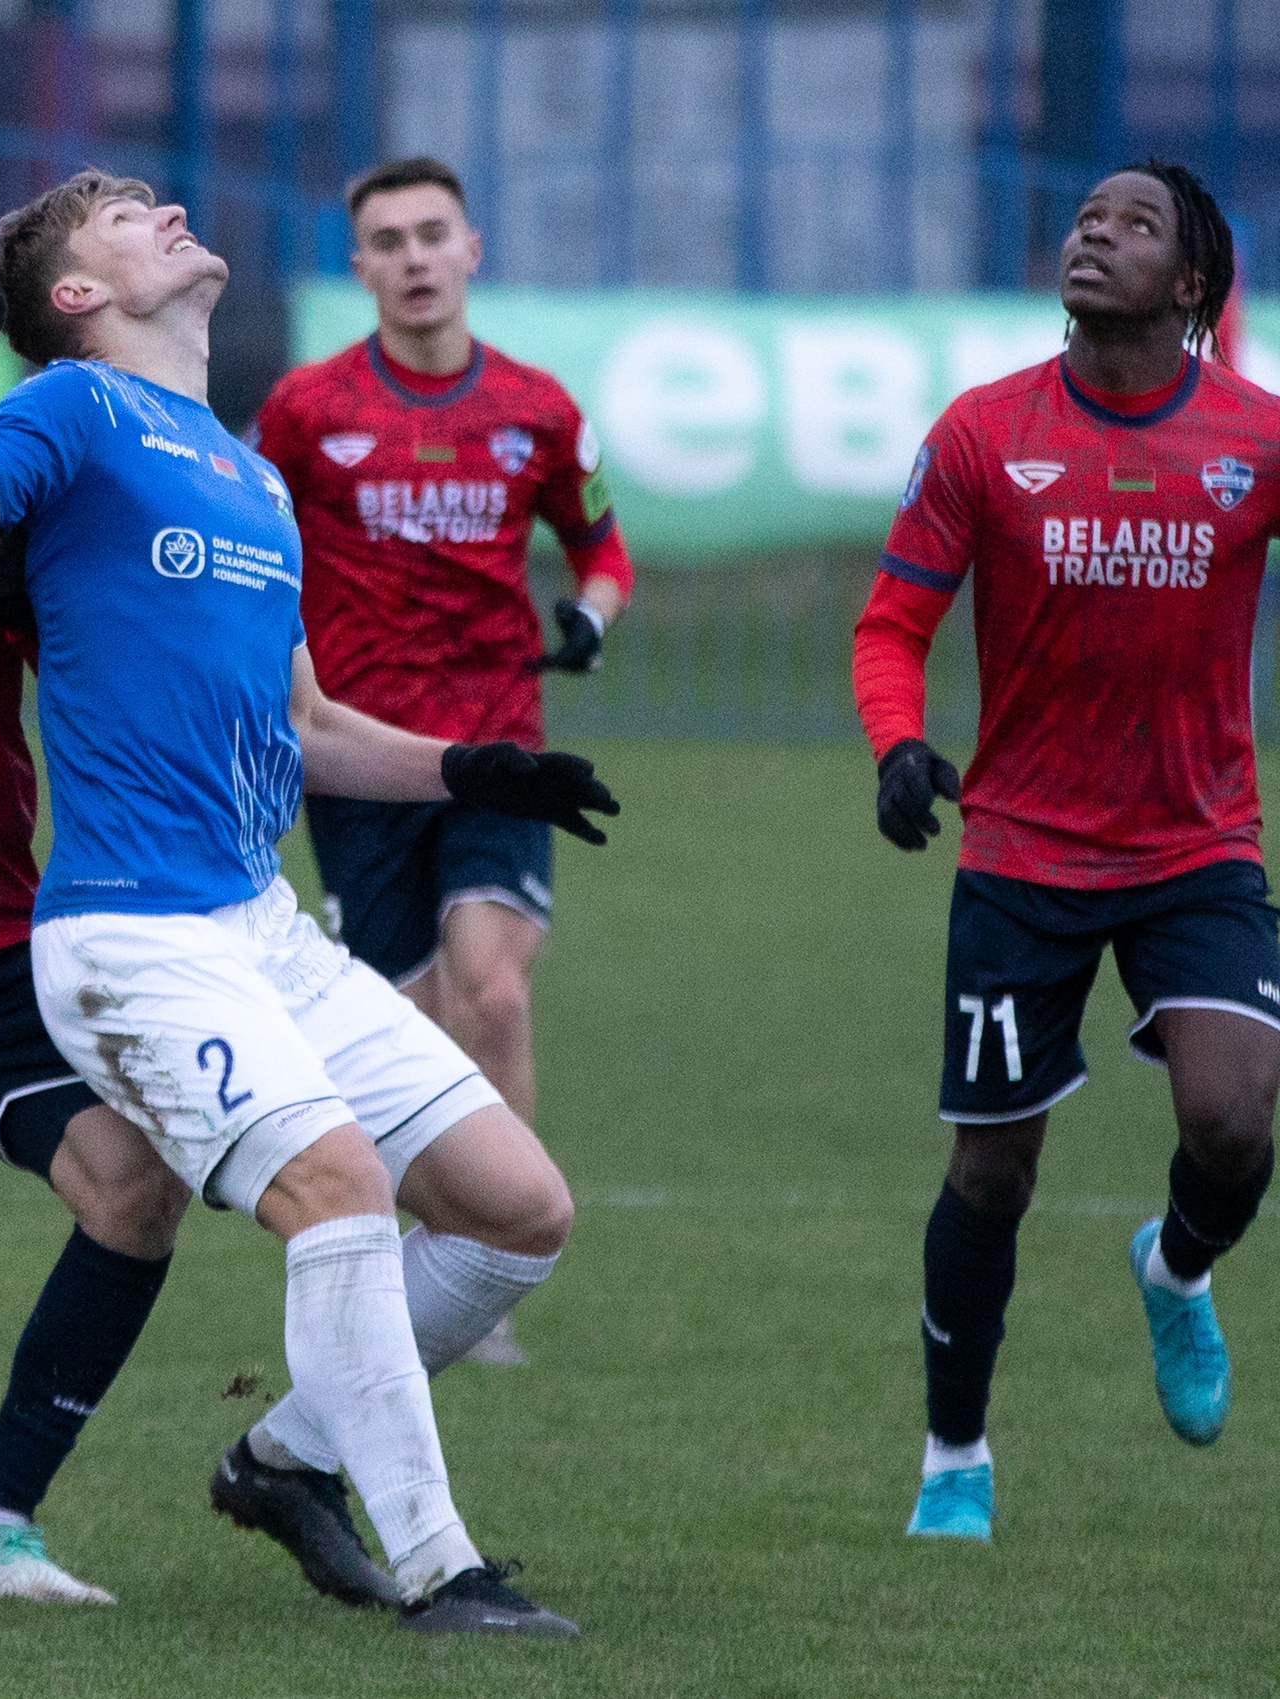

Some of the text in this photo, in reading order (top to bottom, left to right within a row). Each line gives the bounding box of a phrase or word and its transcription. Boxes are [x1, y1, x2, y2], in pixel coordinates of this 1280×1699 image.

[141, 434, 200, 462] uhlsport
[355, 479, 509, 517] BELARUS
[212, 535, 283, 566] ОАО СЛУЦКИЙ
[1043, 517, 1216, 558] BELARUS
[212, 567, 268, 592] КОМБИНАТ
[1043, 553, 1211, 589] TRACTORS
[958, 993, 1023, 1083] 71
[195, 1037, 253, 1112] 2
